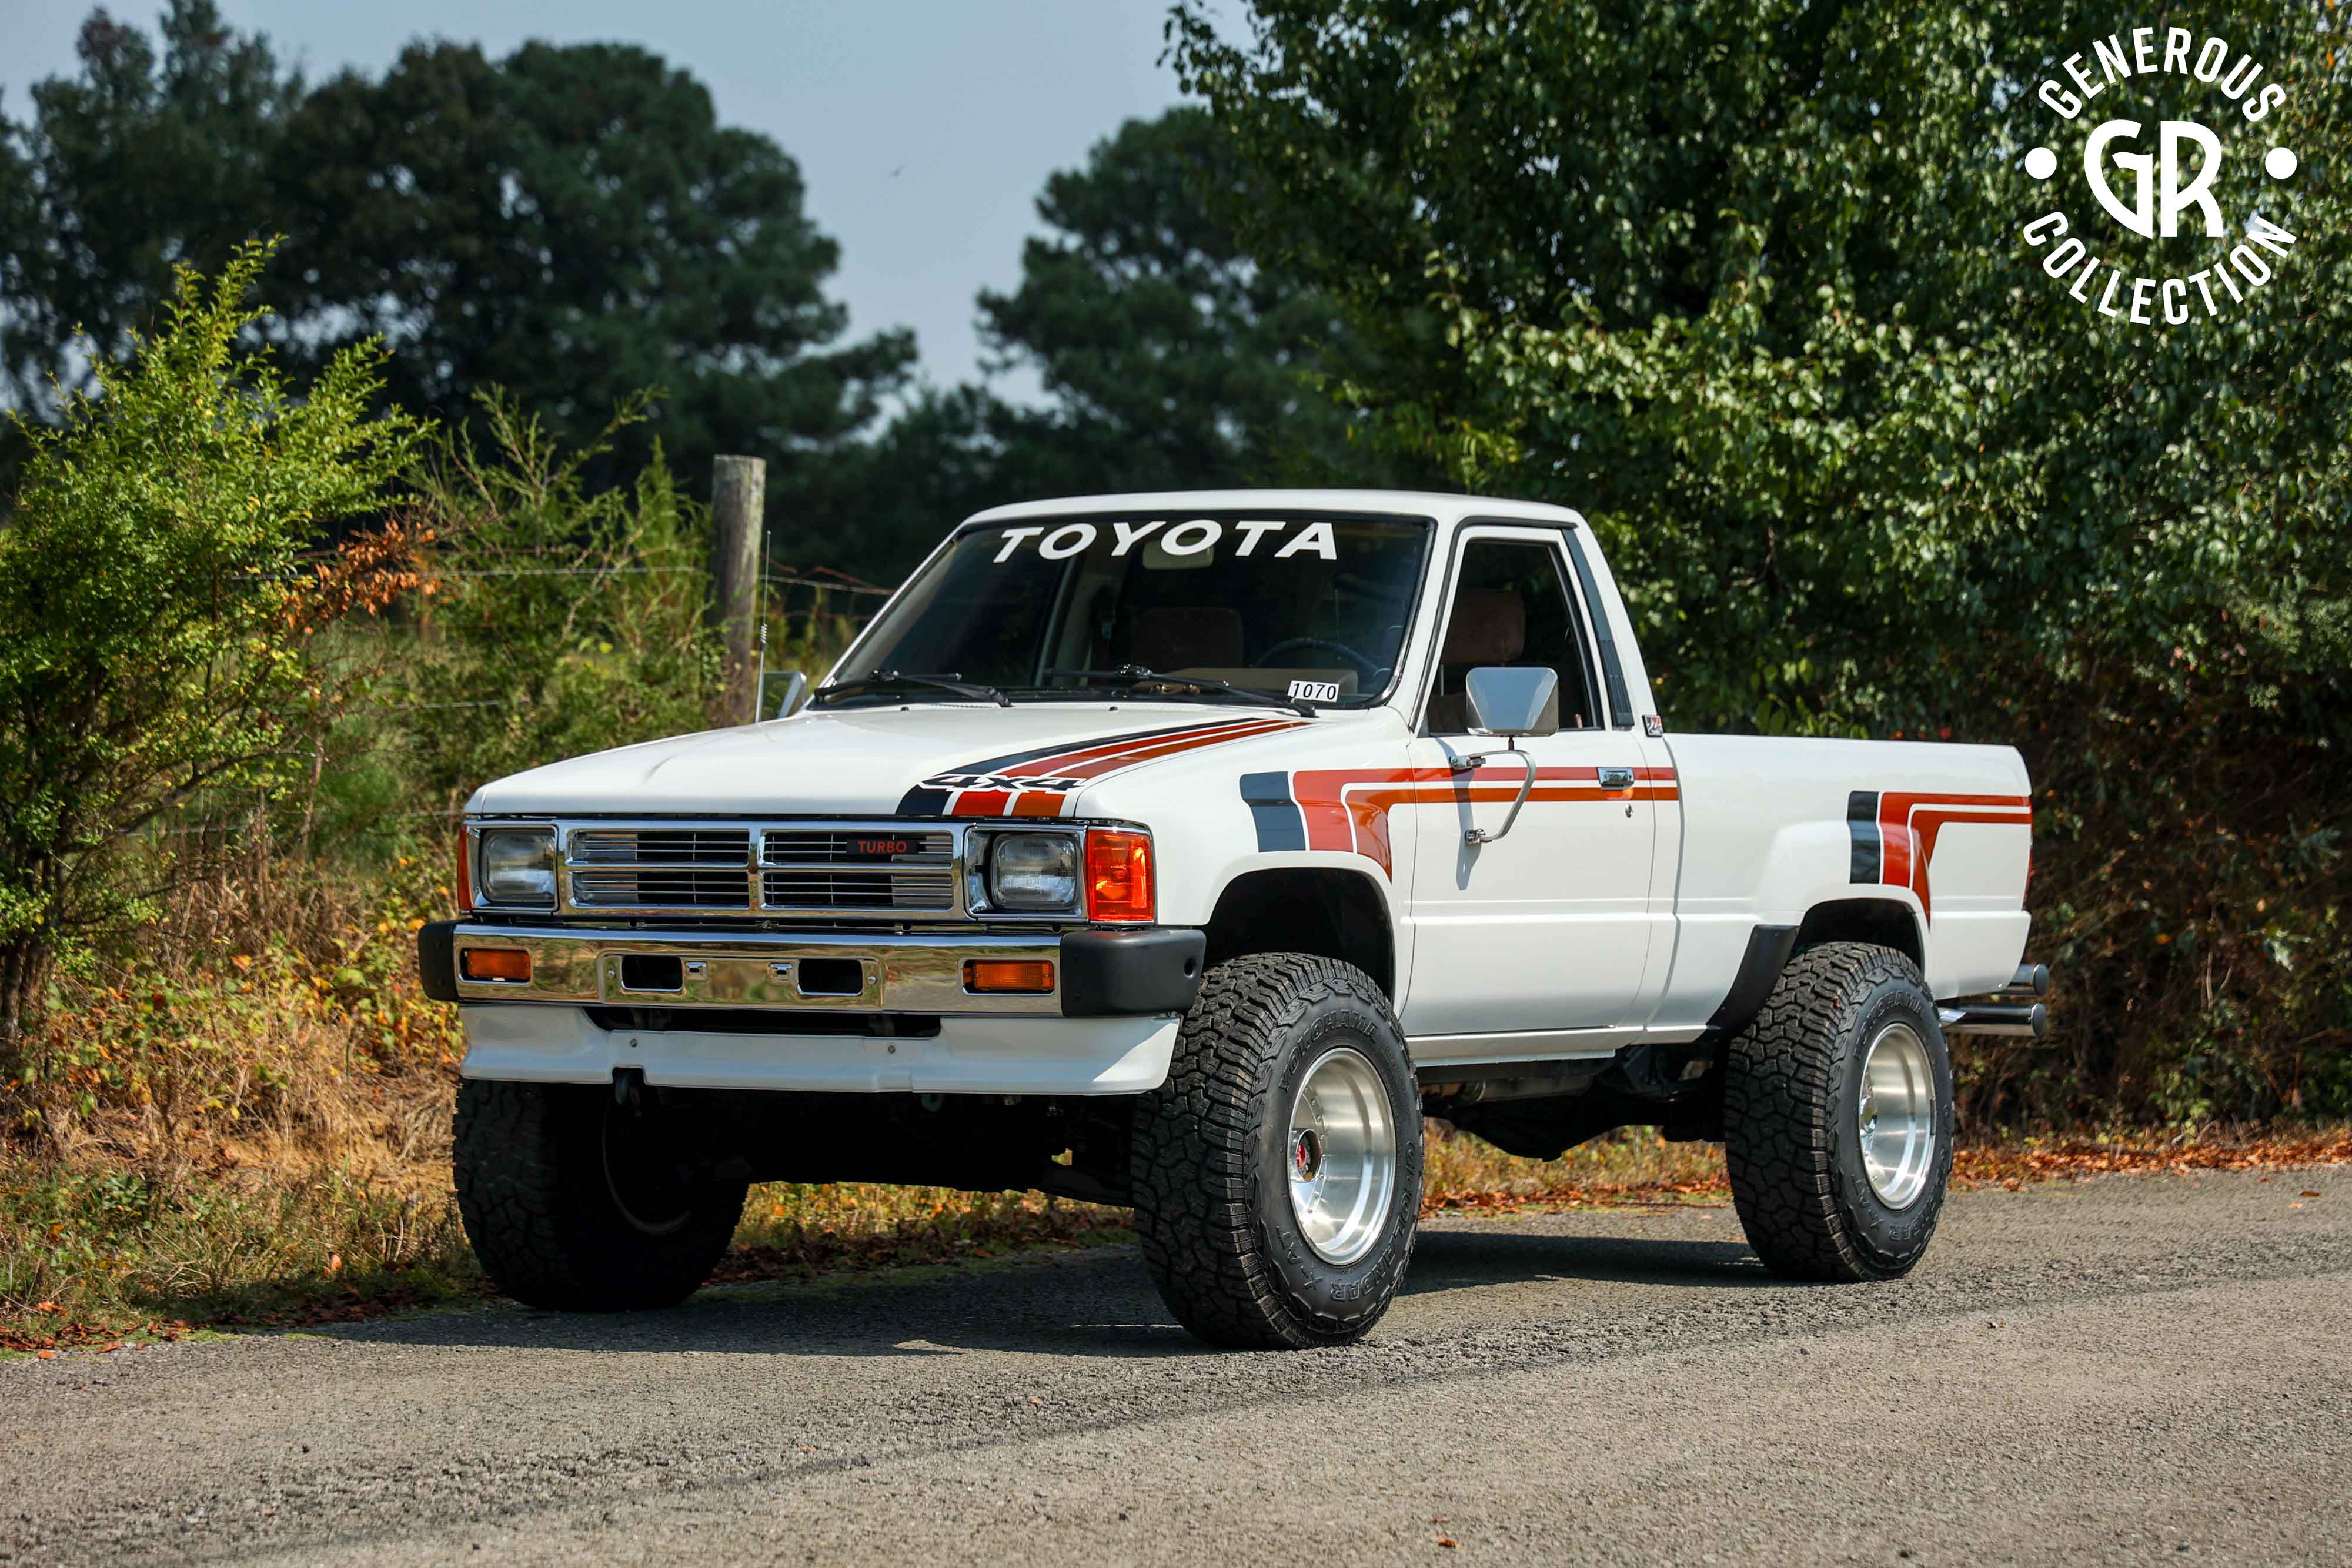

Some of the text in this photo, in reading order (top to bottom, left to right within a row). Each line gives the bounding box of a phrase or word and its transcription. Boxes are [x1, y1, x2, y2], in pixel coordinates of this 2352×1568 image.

[993, 519, 1338, 564] TOYOTA
[1294, 683, 1337, 700] 1070
[858, 840, 907, 854] TURBO
[1279, 1009, 1379, 1093] YOKOHAMA
